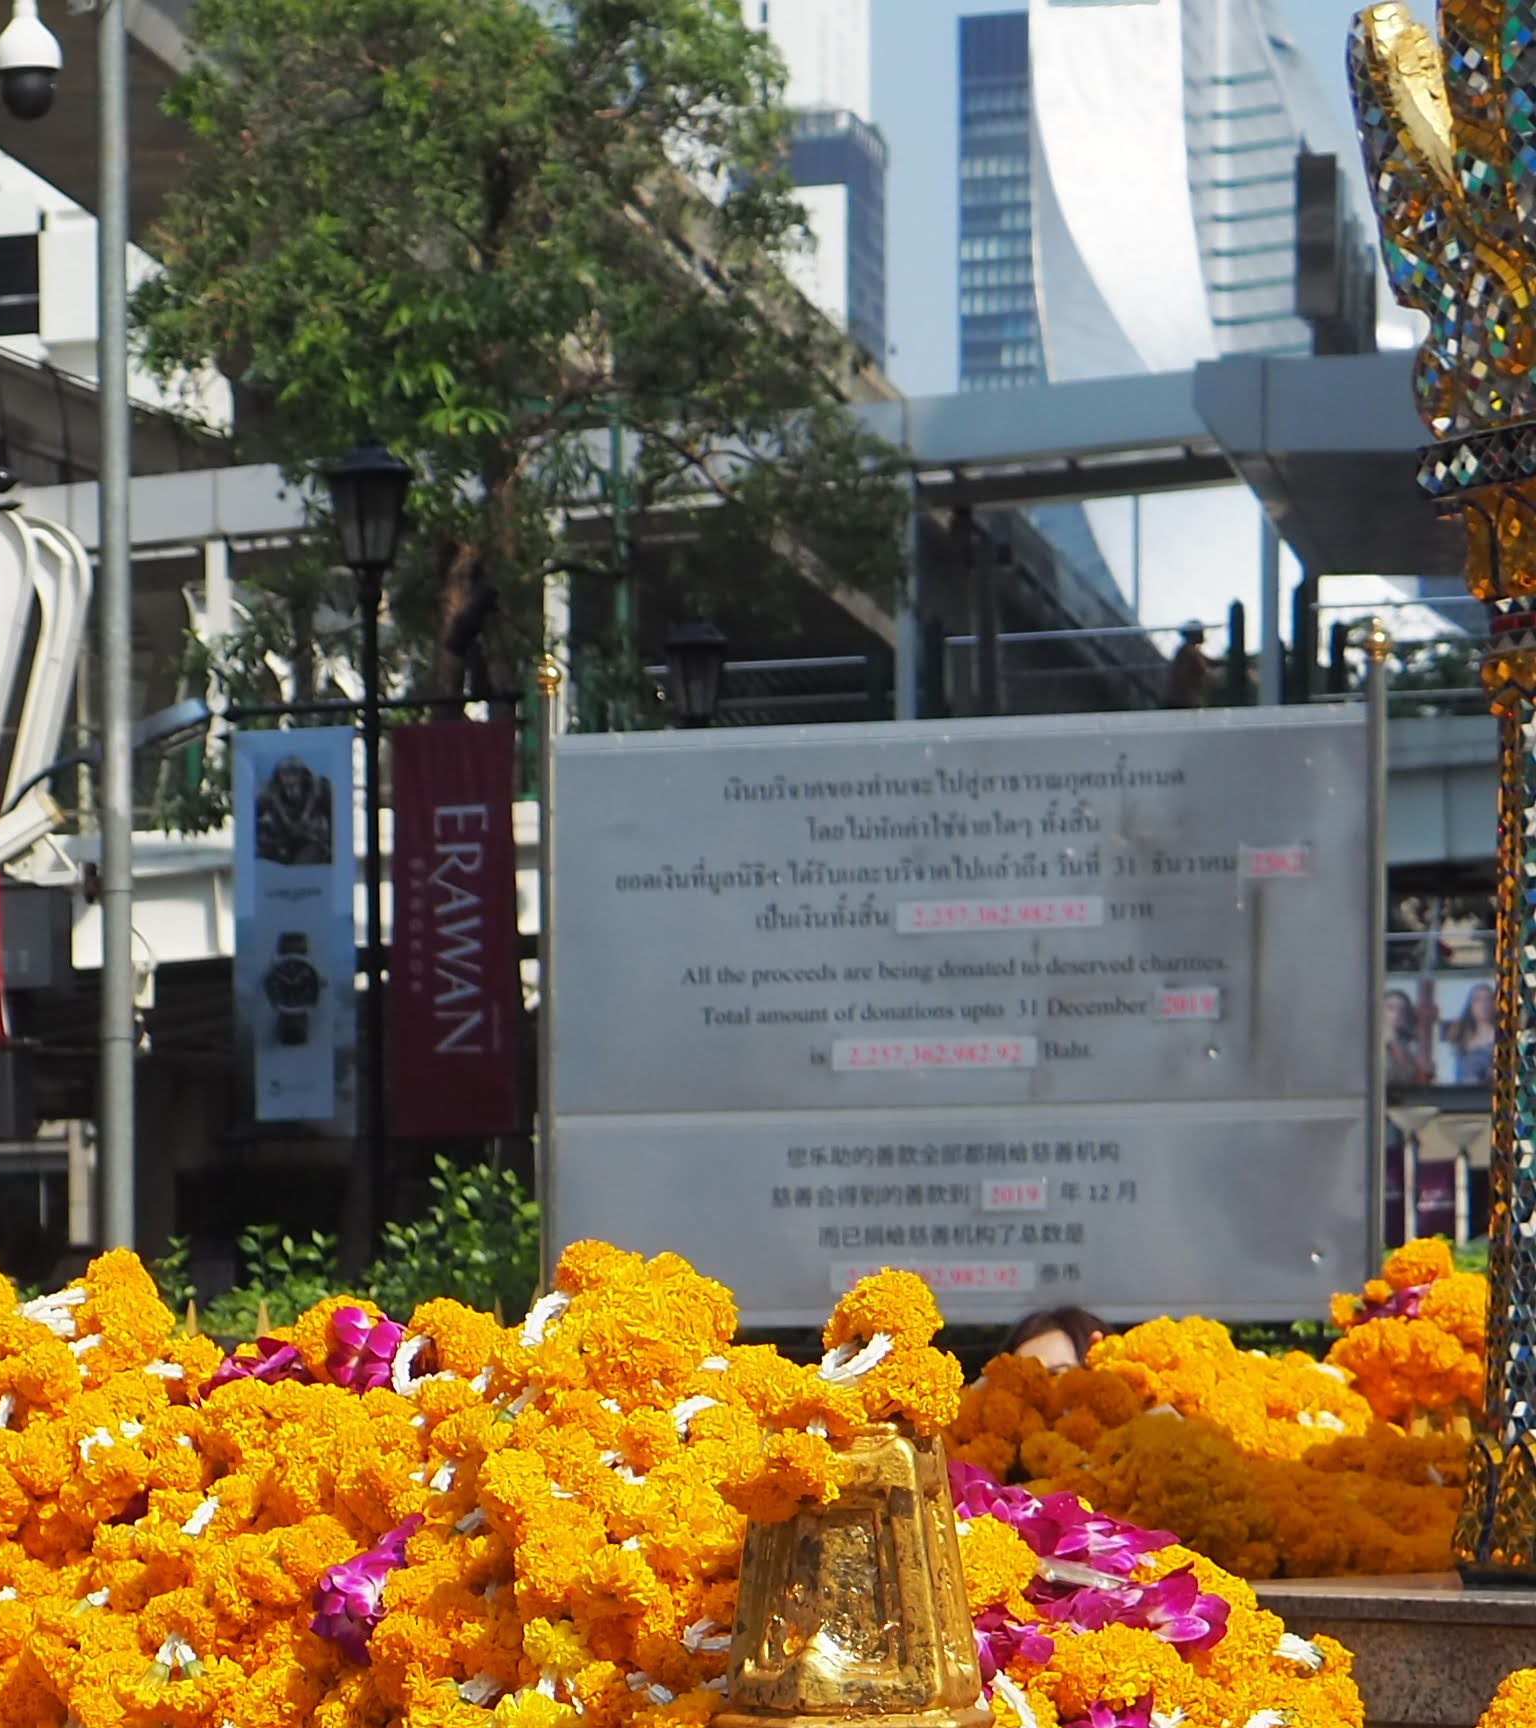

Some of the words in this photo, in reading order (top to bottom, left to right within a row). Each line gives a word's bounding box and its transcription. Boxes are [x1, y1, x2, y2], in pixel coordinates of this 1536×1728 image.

[428, 803, 489, 1055] ERAWAN
[682, 966, 711, 985] All
[717, 966, 746, 985] the
[751, 964, 838, 988] proceeds
[843, 967, 872, 981] are
[878, 961, 934, 984] being
[938, 959, 1016, 978] donated
[1022, 960, 1039, 976] to
[1045, 955, 1135, 976] deserved
[701, 1005, 751, 1026] Total
[757, 1006, 828, 1024] amount
[834, 1004, 857, 1023] of
[861, 1001, 954, 1021] donations
[960, 1004, 1005, 1025] upto
[1017, 999, 1038, 1018] 31
[1047, 998, 1147, 1018] December
[991, 1184, 1041, 1206] 2019
[1089, 1184, 1110, 1201] 12
